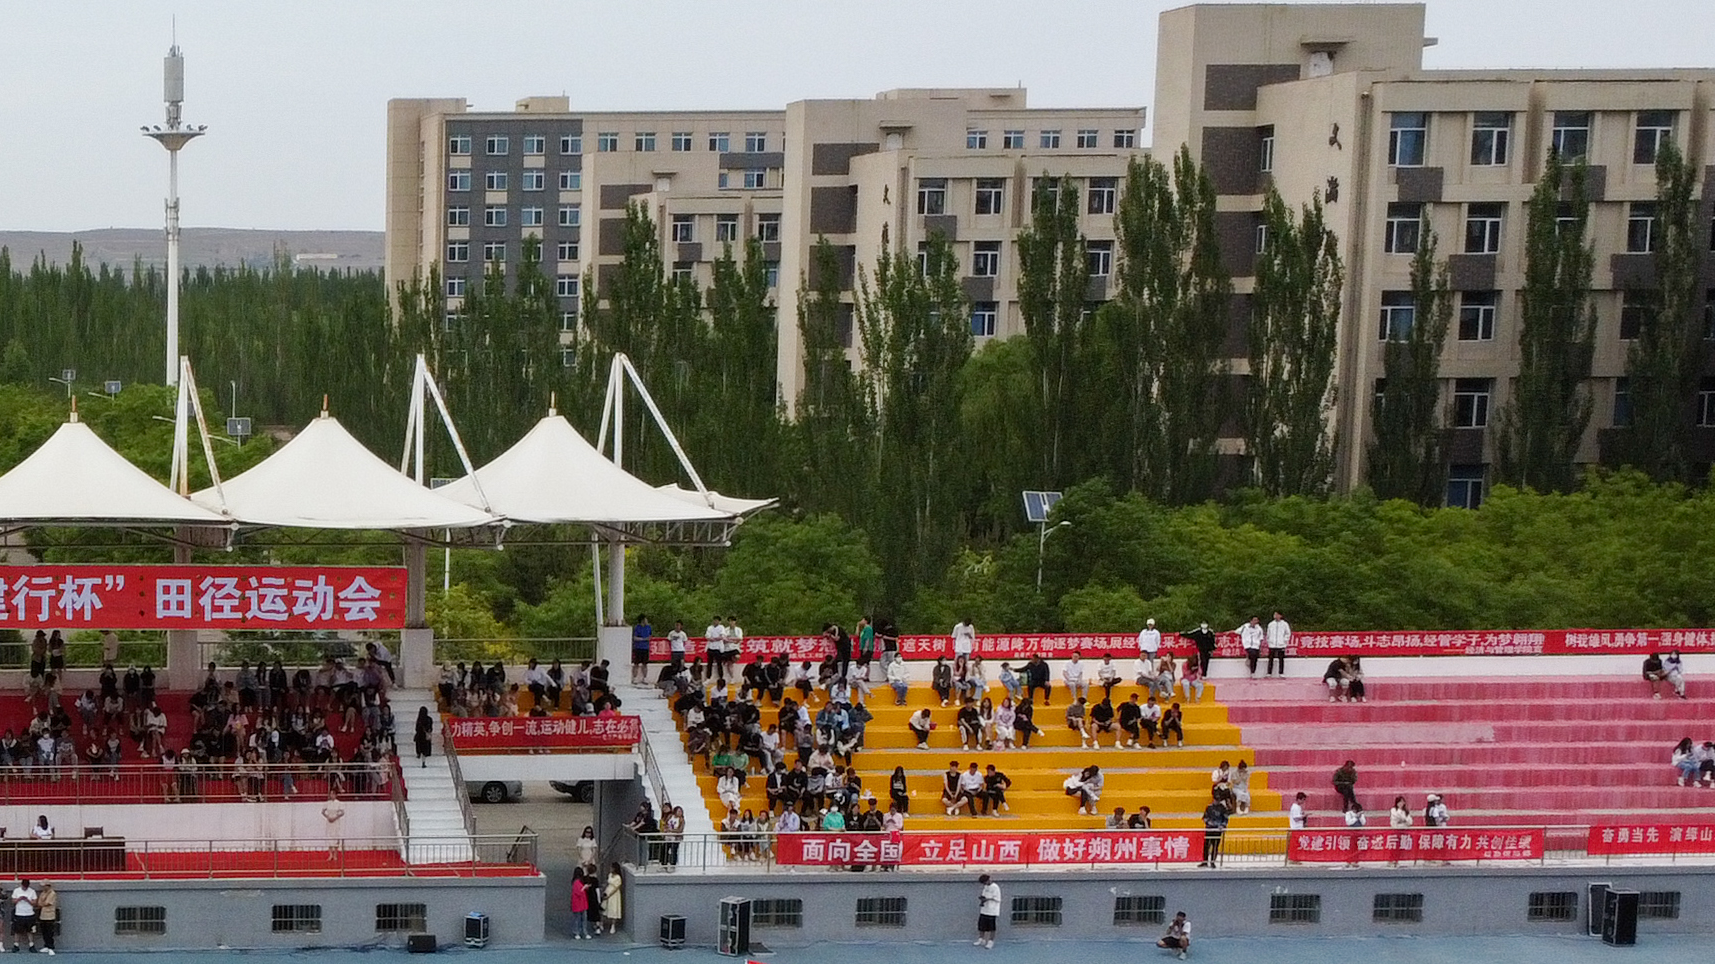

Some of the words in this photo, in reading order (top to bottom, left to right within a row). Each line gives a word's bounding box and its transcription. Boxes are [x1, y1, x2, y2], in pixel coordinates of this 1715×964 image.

[156, 574, 382, 623] 田径运动会
[1357, 834, 1413, 850] 奋进后勤
[1418, 833, 1472, 850] 保障有力
[1602, 827, 1660, 843] 奋勇当先
[801, 837, 902, 863] 面向全国
[920, 838, 1022, 862] 立足山西
[1037, 835, 1190, 861] 做好朔州事情
